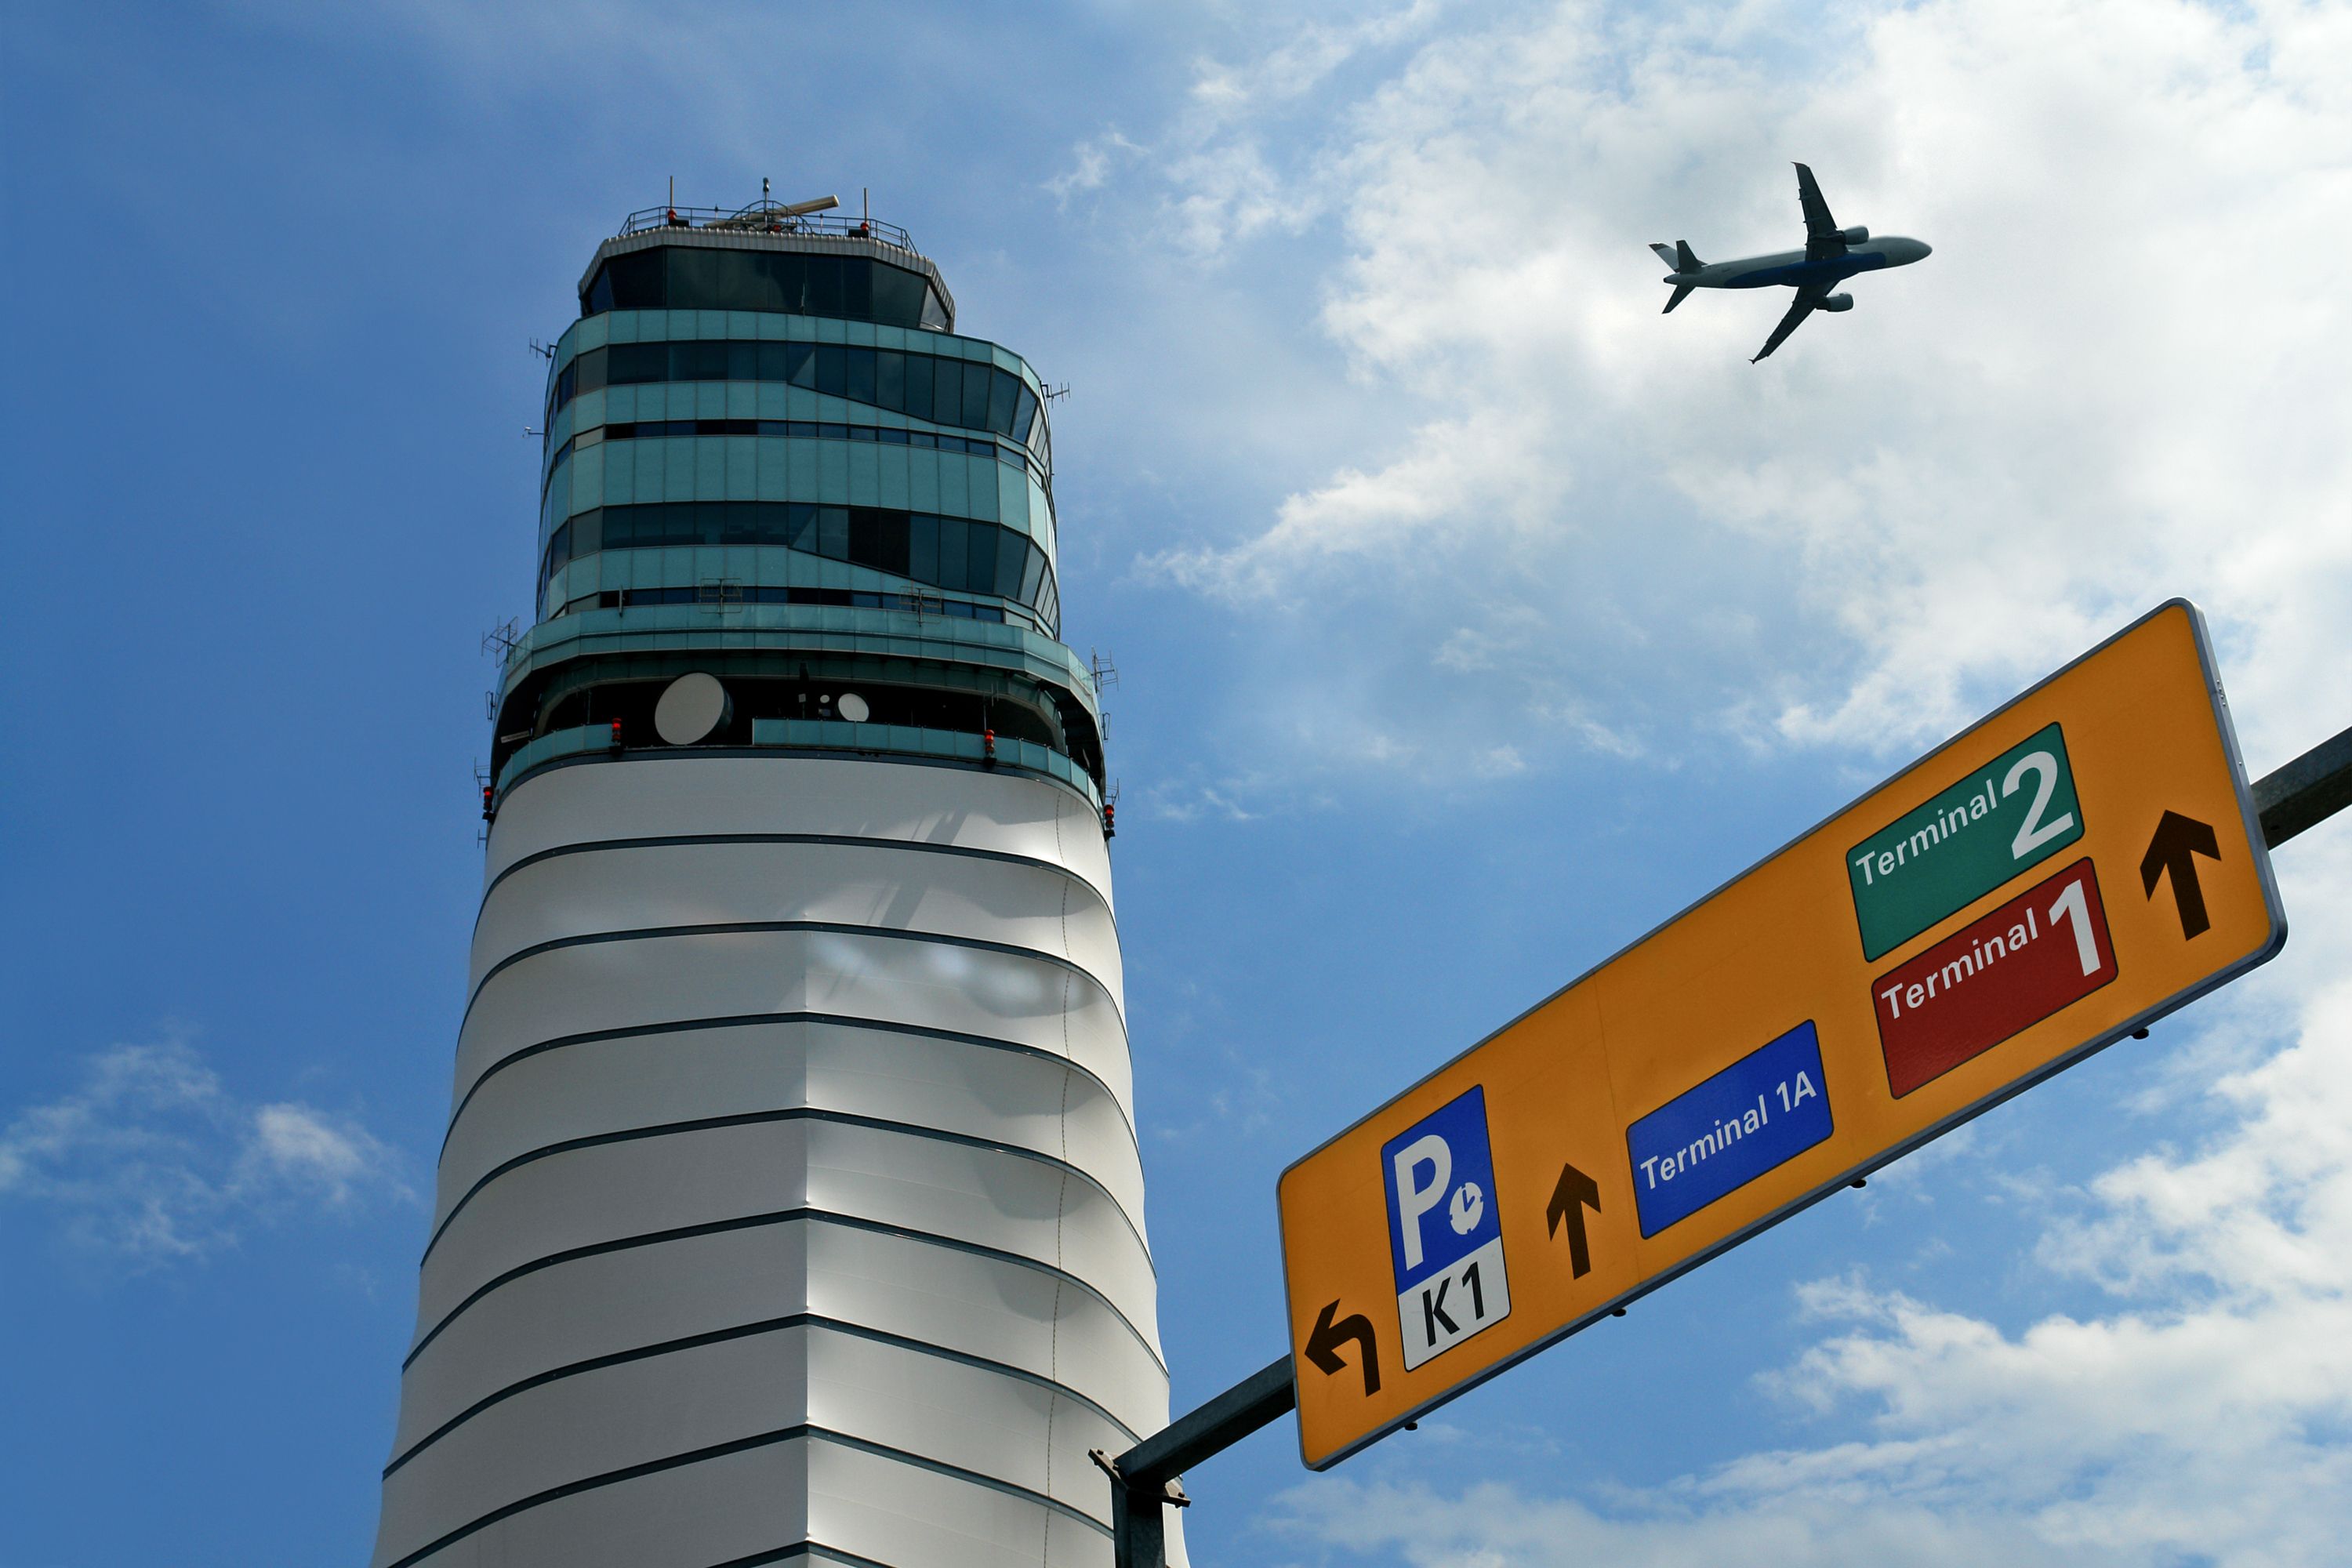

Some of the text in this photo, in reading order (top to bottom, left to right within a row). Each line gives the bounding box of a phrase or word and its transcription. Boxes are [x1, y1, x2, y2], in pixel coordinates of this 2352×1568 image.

[1856, 751, 2074, 885] Terminal 2
[1881, 879, 2101, 1019] Terminal 1
[1640, 1070, 1817, 1190] Terminal 1A
[1394, 1134, 1452, 1271] P
[1422, 1261, 1486, 1348] K1
